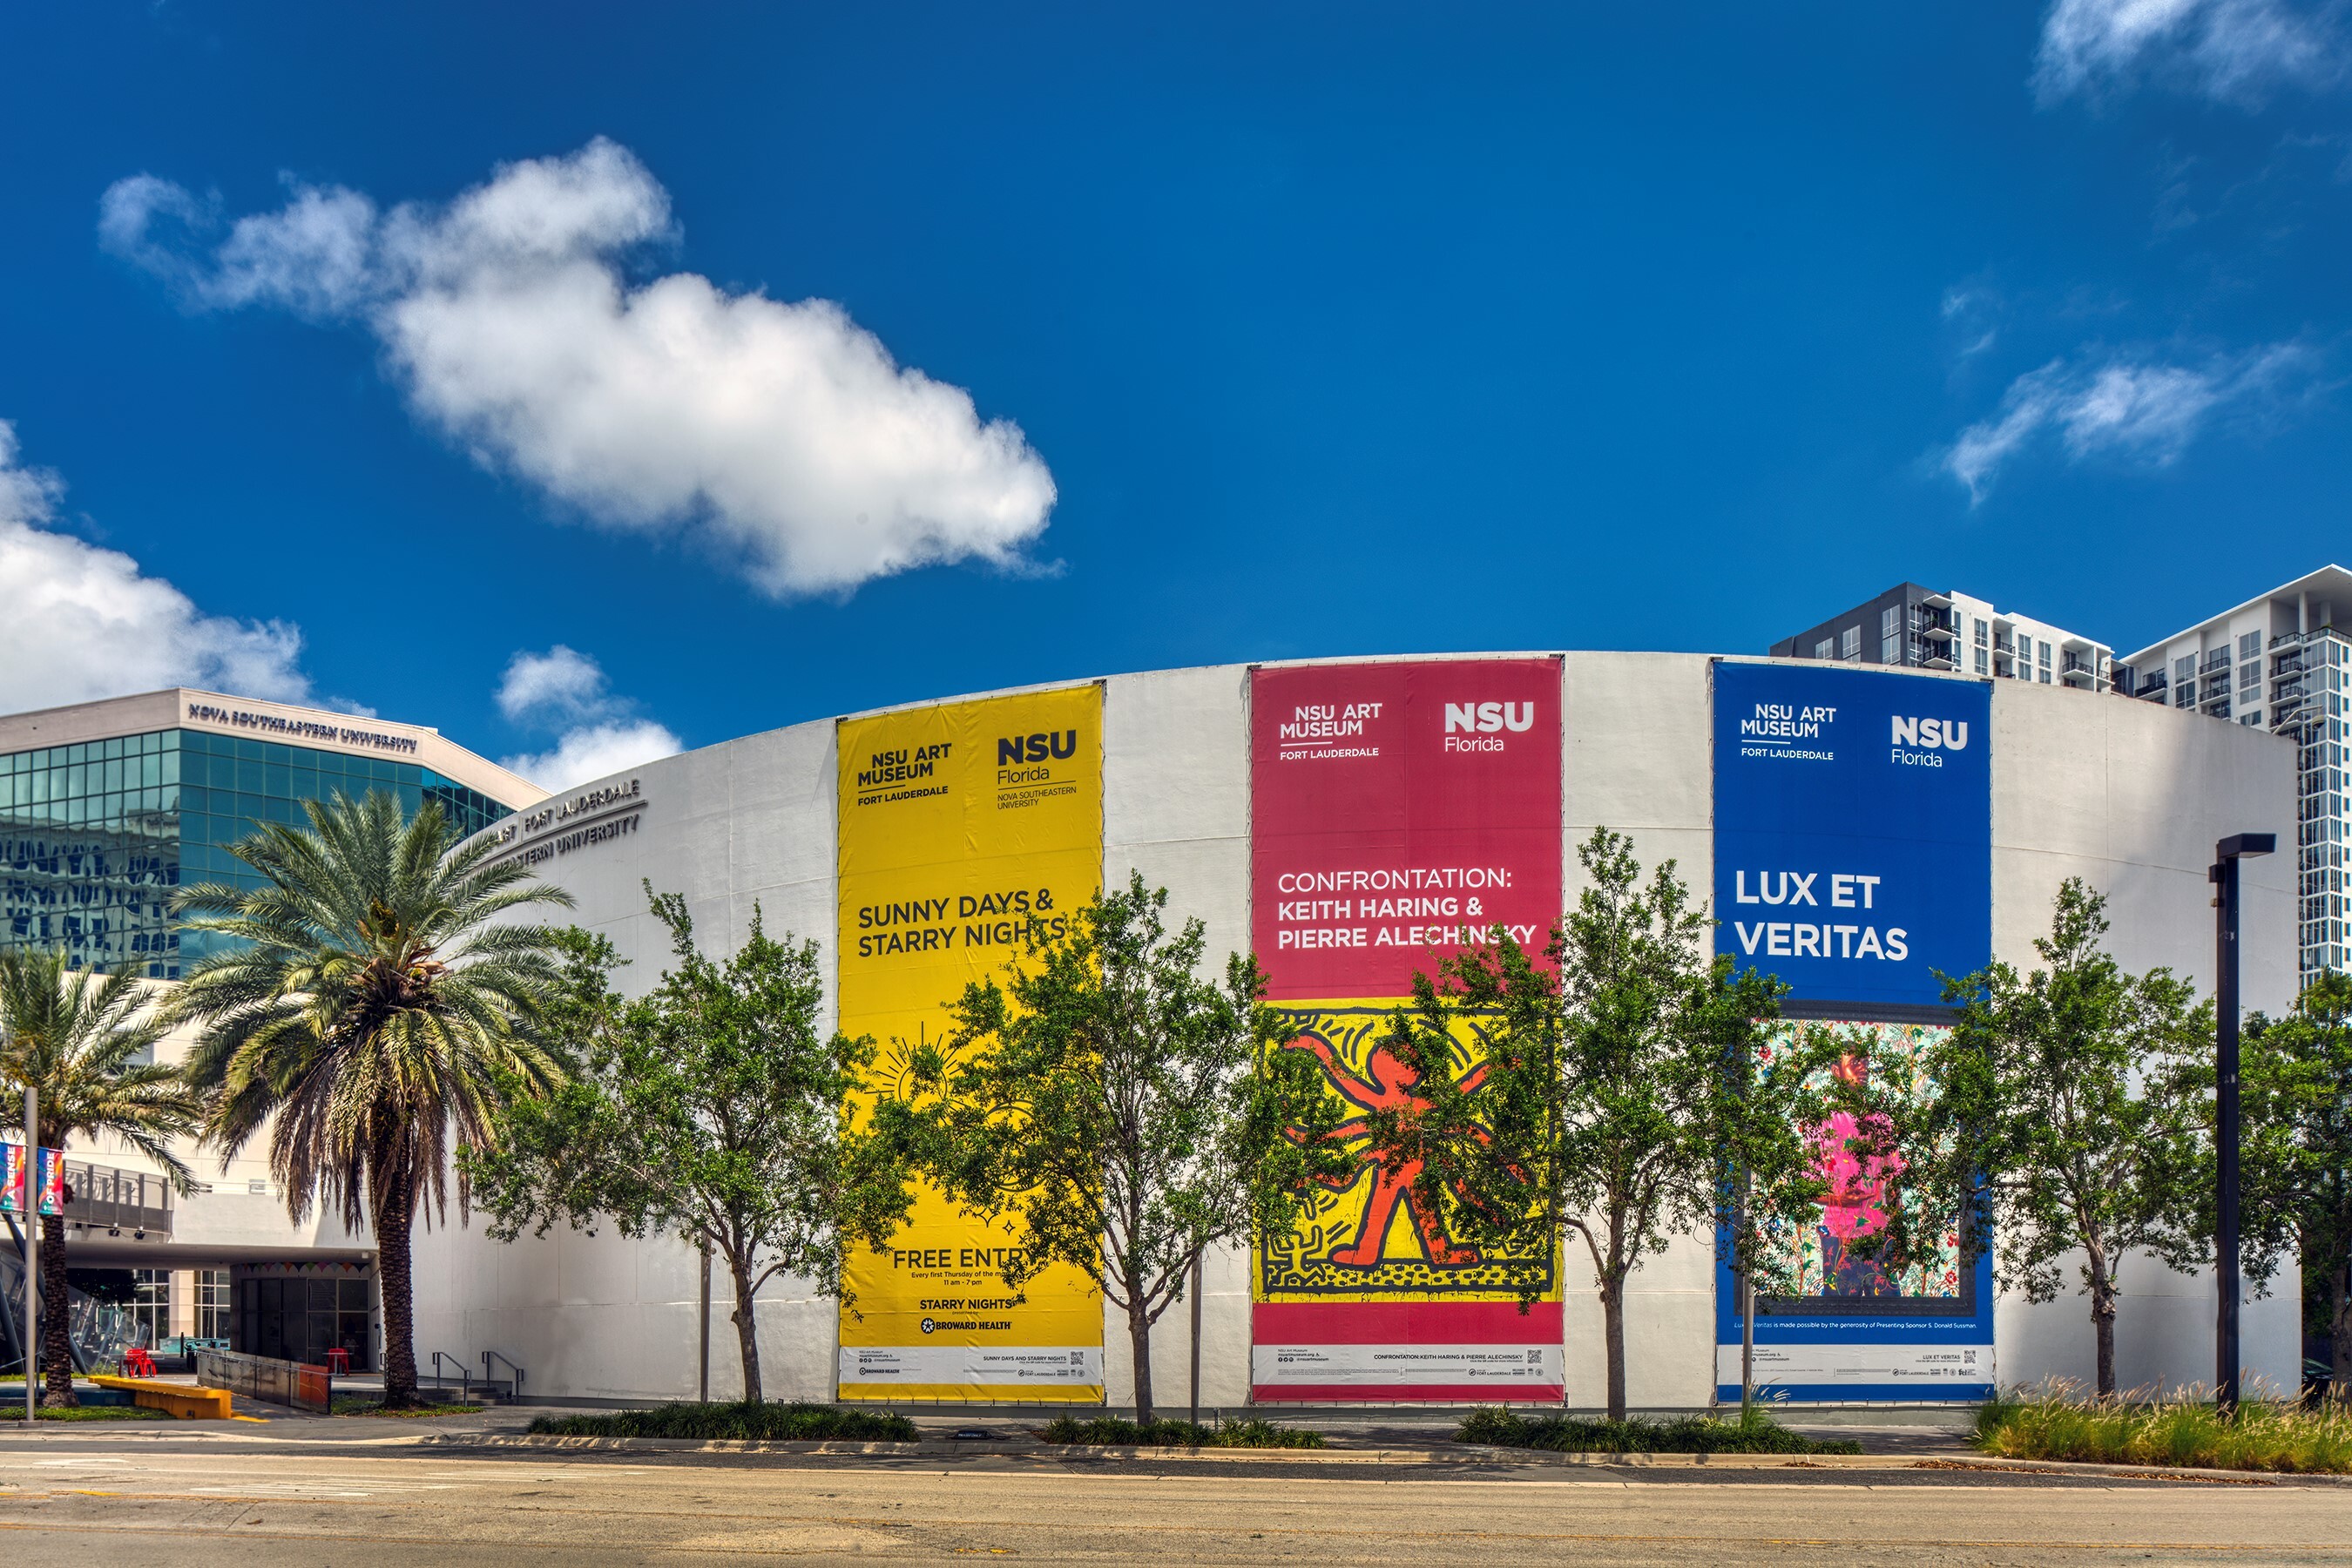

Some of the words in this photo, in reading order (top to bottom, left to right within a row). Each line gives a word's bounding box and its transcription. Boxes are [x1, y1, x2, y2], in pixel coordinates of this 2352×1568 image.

[1295, 705, 1335, 721] NSU
[1342, 702, 1382, 720] ART
[1445, 701, 1534, 733] NSU
[1755, 703, 1793, 720] NSU
[1801, 706, 1836, 723] ART
[189, 704, 228, 720] NOVA
[233, 710, 338, 739] SOUTHEASTERN
[341, 728, 417, 751] UNIVERSITY
[1280, 720, 1362, 739] MUSEUM
[1741, 720, 1818, 738] MUSEUM
[1891, 715, 1968, 750] NSU
[872, 748, 908, 767] NSU
[915, 742, 952, 762] ART
[997, 729, 1077, 766] NSU
[1280, 750, 1308, 760] FORT
[1310, 747, 1379, 760] LAUDERDALE
[1445, 736, 1504, 753] Florida
[1741, 747, 1767, 757] FORT
[1769, 749, 1834, 760] LAUDERDALE
[1891, 749, 1943, 767] Florida
[858, 761, 933, 787] MUSEUM
[997, 766, 1050, 784] Florida
[858, 794, 883, 806] FORT
[885, 786, 949, 802] LAUDERDALE
[997, 791, 1017, 801] NOVA
[1019, 786, 1077, 799] SOUTHEASTERN
[997, 798, 1039, 810] UNIVERSITY
[525, 809, 552, 831] FORT
[556, 779, 639, 821] LAUDERDALE
[557, 814, 640, 854] UNIVERSITY
[1278, 868, 1512, 893] CONFRONTATION:
[1736, 870, 1818, 906] LUX
[1832, 874, 1881, 909] ET
[858, 897, 950, 929] SUNNY
[959, 890, 1030, 919] DAYS
[1035, 888, 1054, 910] &
[1279, 900, 1350, 921] KEITH
[1360, 896, 1459, 920] HARING
[1466, 896, 1484, 916] &
[858, 926, 956, 957] STARRY
[965, 916, 1065, 947] NIGHTS
[1279, 928, 1367, 950] PIERRE
[1734, 922, 1909, 962] VERITAS
[7, 1146, 16, 1187] SENSE
[46, 1152, 55, 1186] PRIDE
[7, 1189, 16, 1200] A
[46, 1186, 55, 1204] OF
[894, 1249, 951, 1269] FREE
[920, 1299, 965, 1309] STARRY
[968, 1299, 1013, 1309] NIGHTS
[936, 1321, 977, 1330] BROWARD
[978, 1321, 1010, 1330] HEALTH
